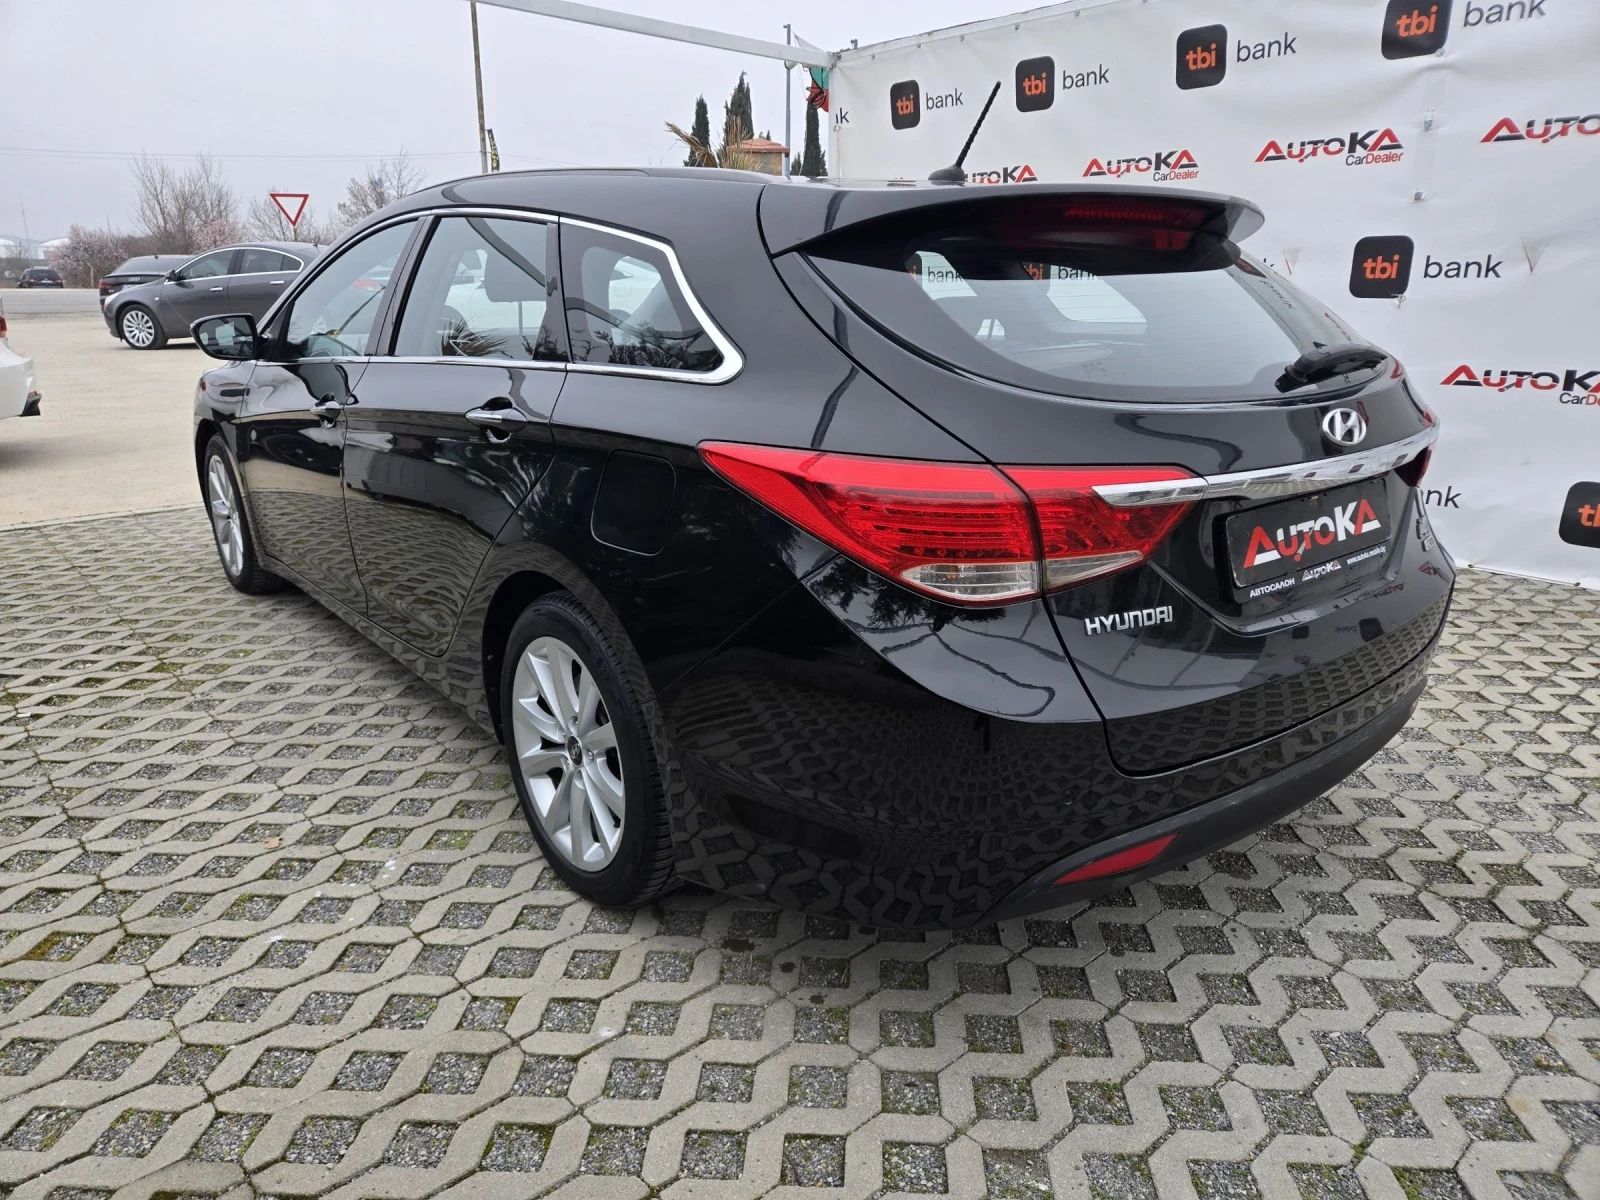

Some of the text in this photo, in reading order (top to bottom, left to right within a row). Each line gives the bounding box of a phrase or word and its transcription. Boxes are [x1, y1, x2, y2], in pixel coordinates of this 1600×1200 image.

[1395, 0, 1547, 38] tbi bank
[1185, 32, 1297, 70] tbi bank
[1022, 64, 1110, 96] tbi bank
[896, 88, 964, 115] tbi bank
[1363, 254, 1504, 279] tbi bank
[1440, 364, 1600, 394] AUTOK
[1558, 391, 1600, 406] CarD
[1425, 485, 1462, 509] nk
[1250, 578, 1295, 598] АВТОСАЛОН
[1084, 605, 1173, 636] HYUNDAI
